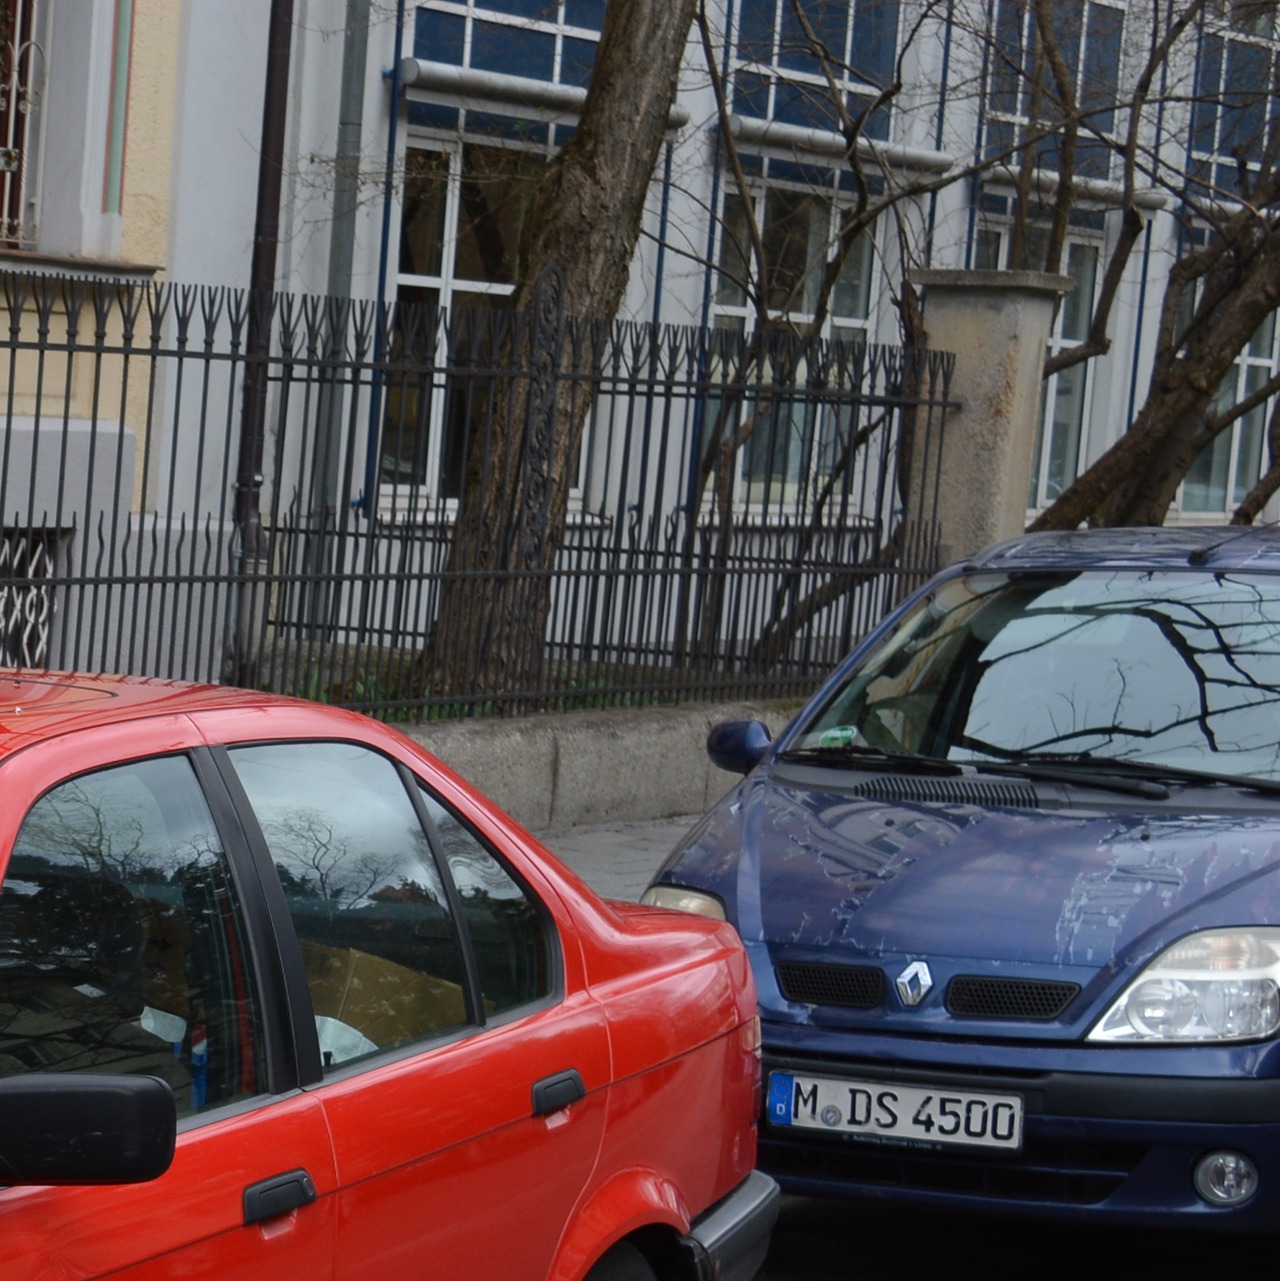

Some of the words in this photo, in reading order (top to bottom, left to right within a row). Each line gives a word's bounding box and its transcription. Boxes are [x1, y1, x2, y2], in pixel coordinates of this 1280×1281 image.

[793, 1082, 819, 1121] M
[847, 1088, 899, 1129] DS
[912, 1096, 1016, 1141] 4500
